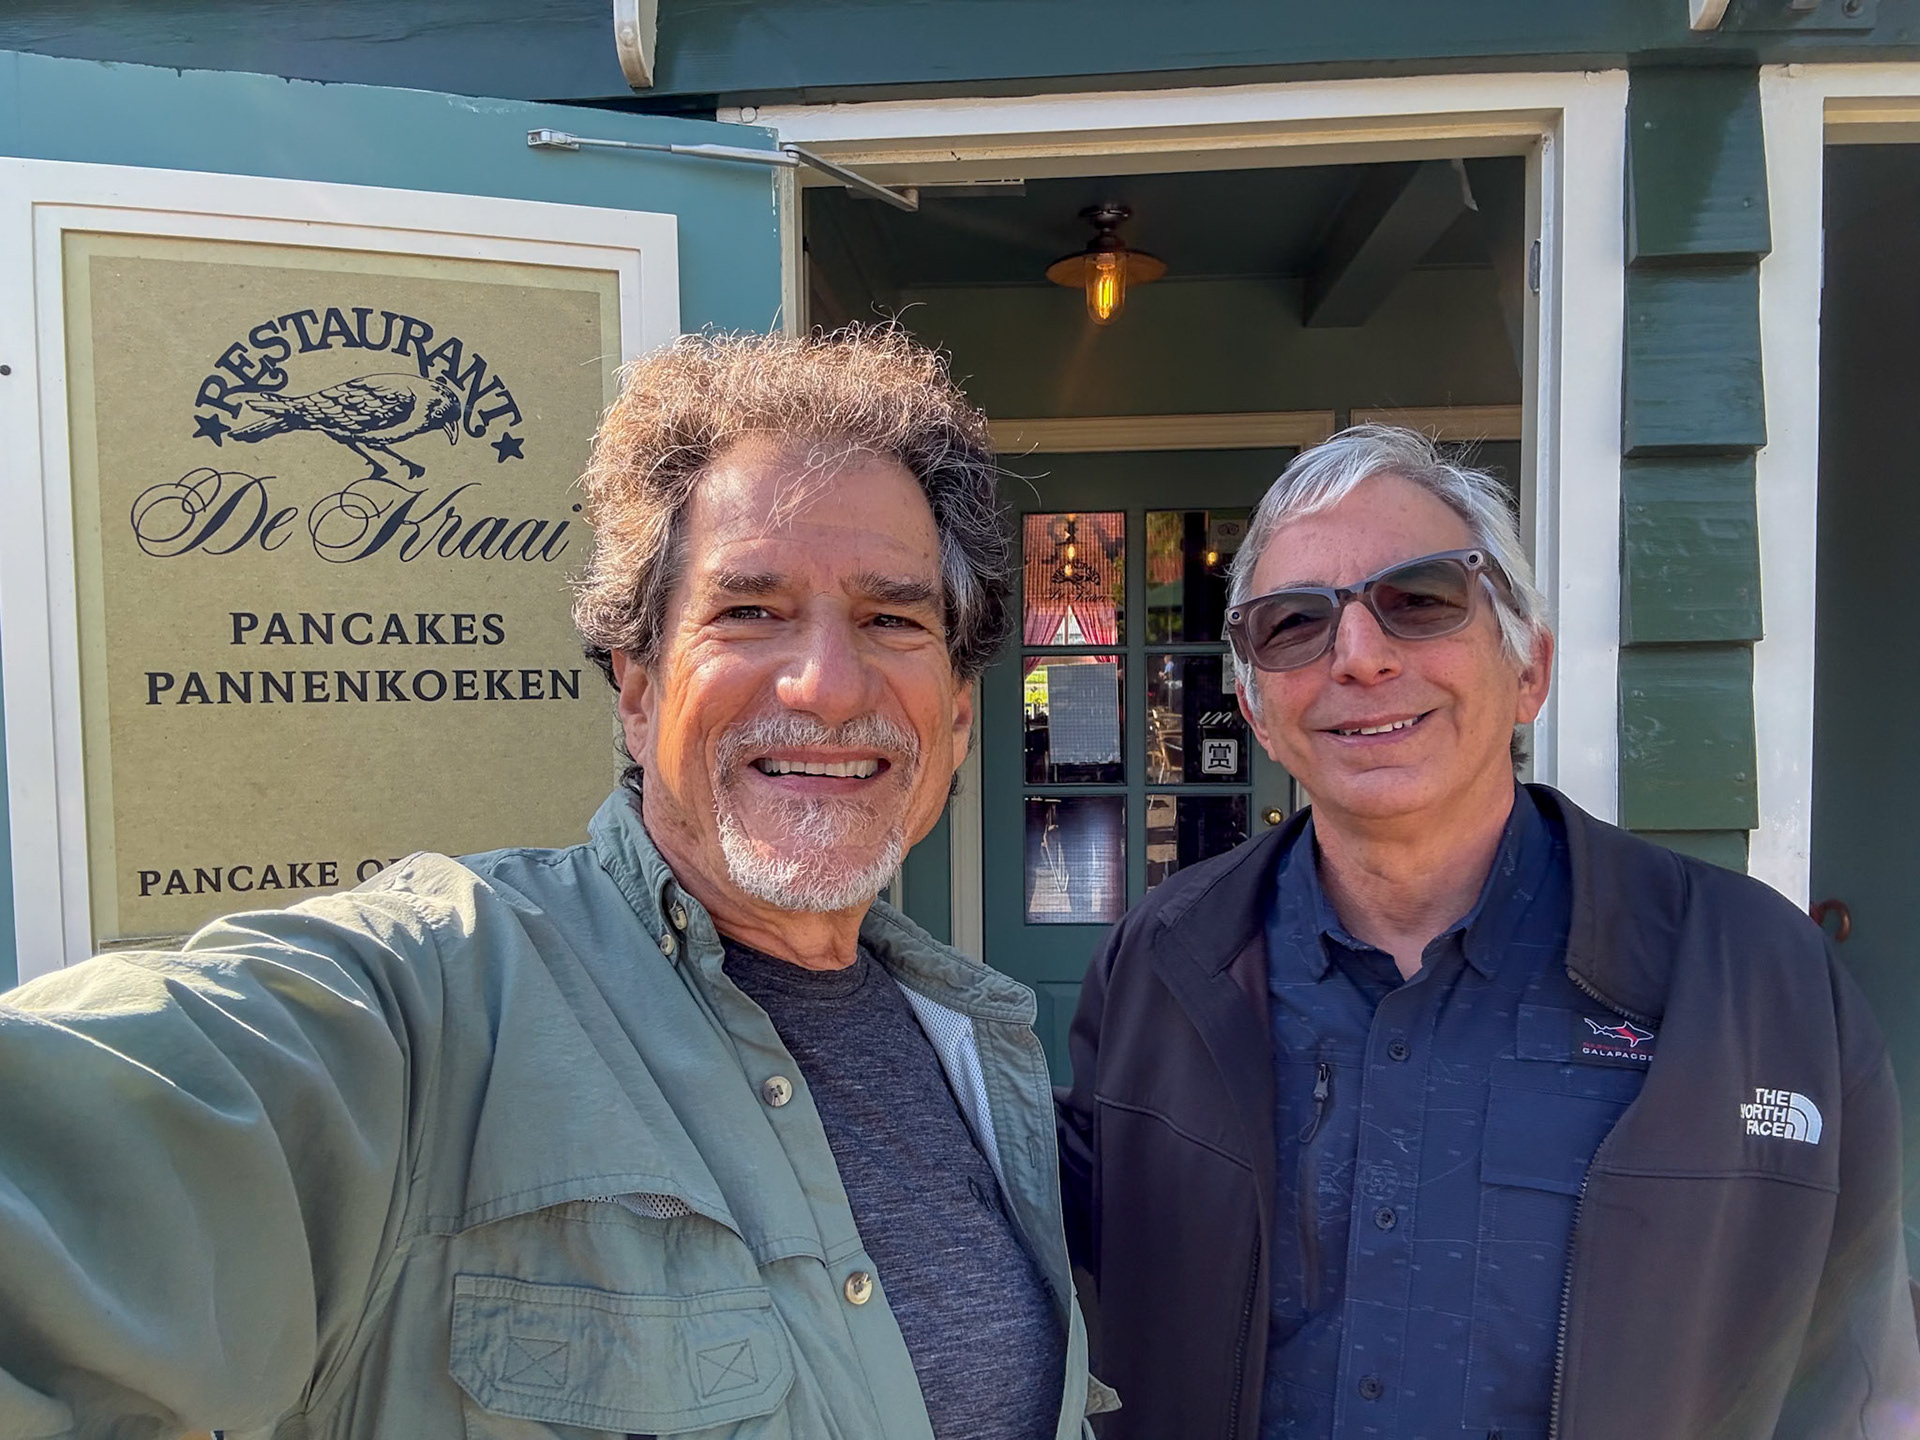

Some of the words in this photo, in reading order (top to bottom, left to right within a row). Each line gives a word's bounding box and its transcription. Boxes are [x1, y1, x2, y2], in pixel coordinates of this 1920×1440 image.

[195, 307, 523, 438] RESTAURANT
[131, 467, 298, 557] De
[308, 478, 583, 563] Kraai
[229, 612, 505, 645] PANCAKES
[144, 669, 582, 705] PANNENKOEKEN
[137, 861, 339, 896] PANCAKE
[1740, 1103, 1787, 1122] NORTH
[1755, 1088, 1790, 1106] THE
[1746, 1120, 1785, 1138] FACE
